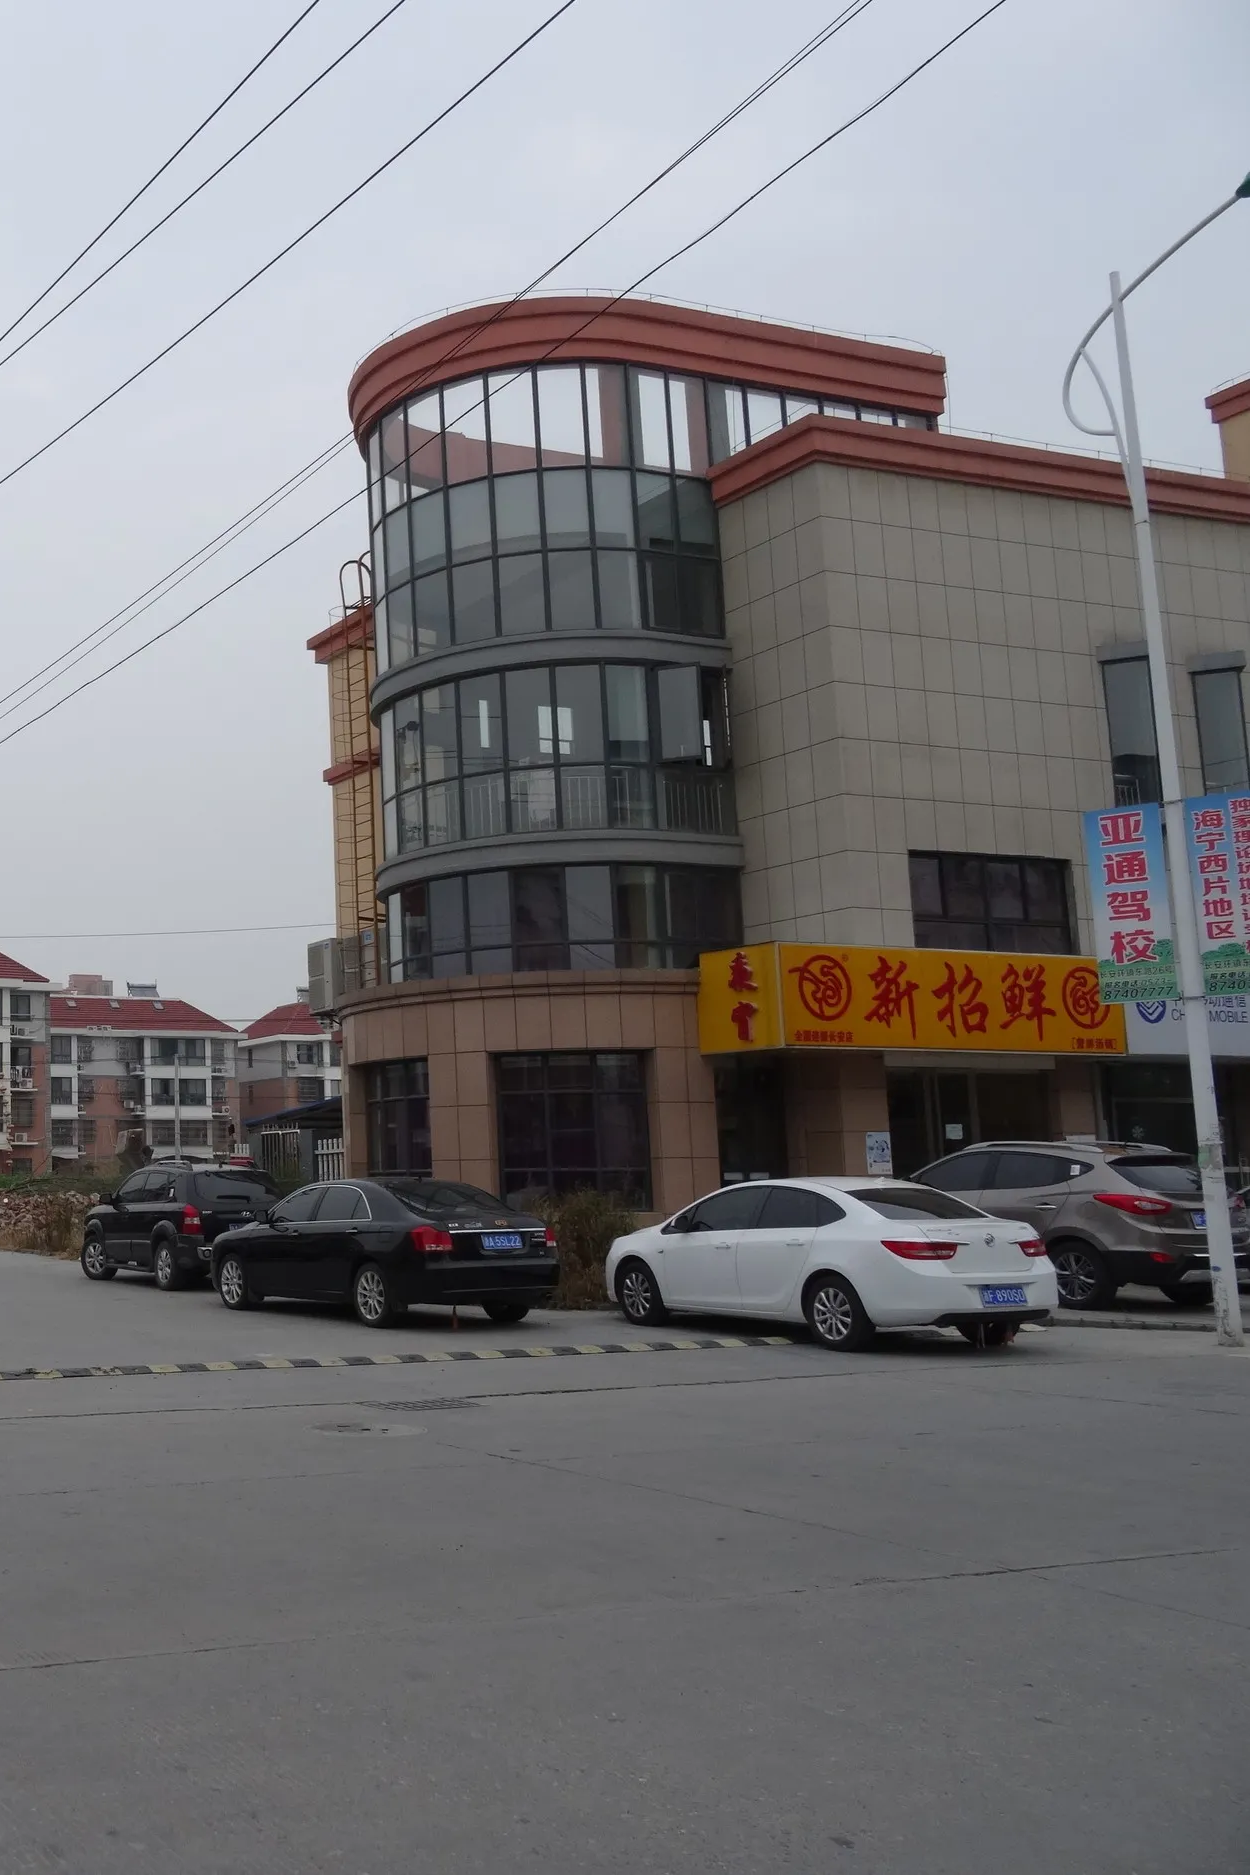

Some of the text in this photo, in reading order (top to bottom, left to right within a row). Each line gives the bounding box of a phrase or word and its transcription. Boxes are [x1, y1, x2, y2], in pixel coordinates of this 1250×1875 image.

[1099, 811, 1158, 964] 亚通驾校
[1193, 809, 1236, 940] 海宁西片地区
[864, 955, 1057, 1042] 新招鲜
[1103, 986, 1174, 1001] 87407777
[1209, 1010, 1249, 1023] MOBILE
